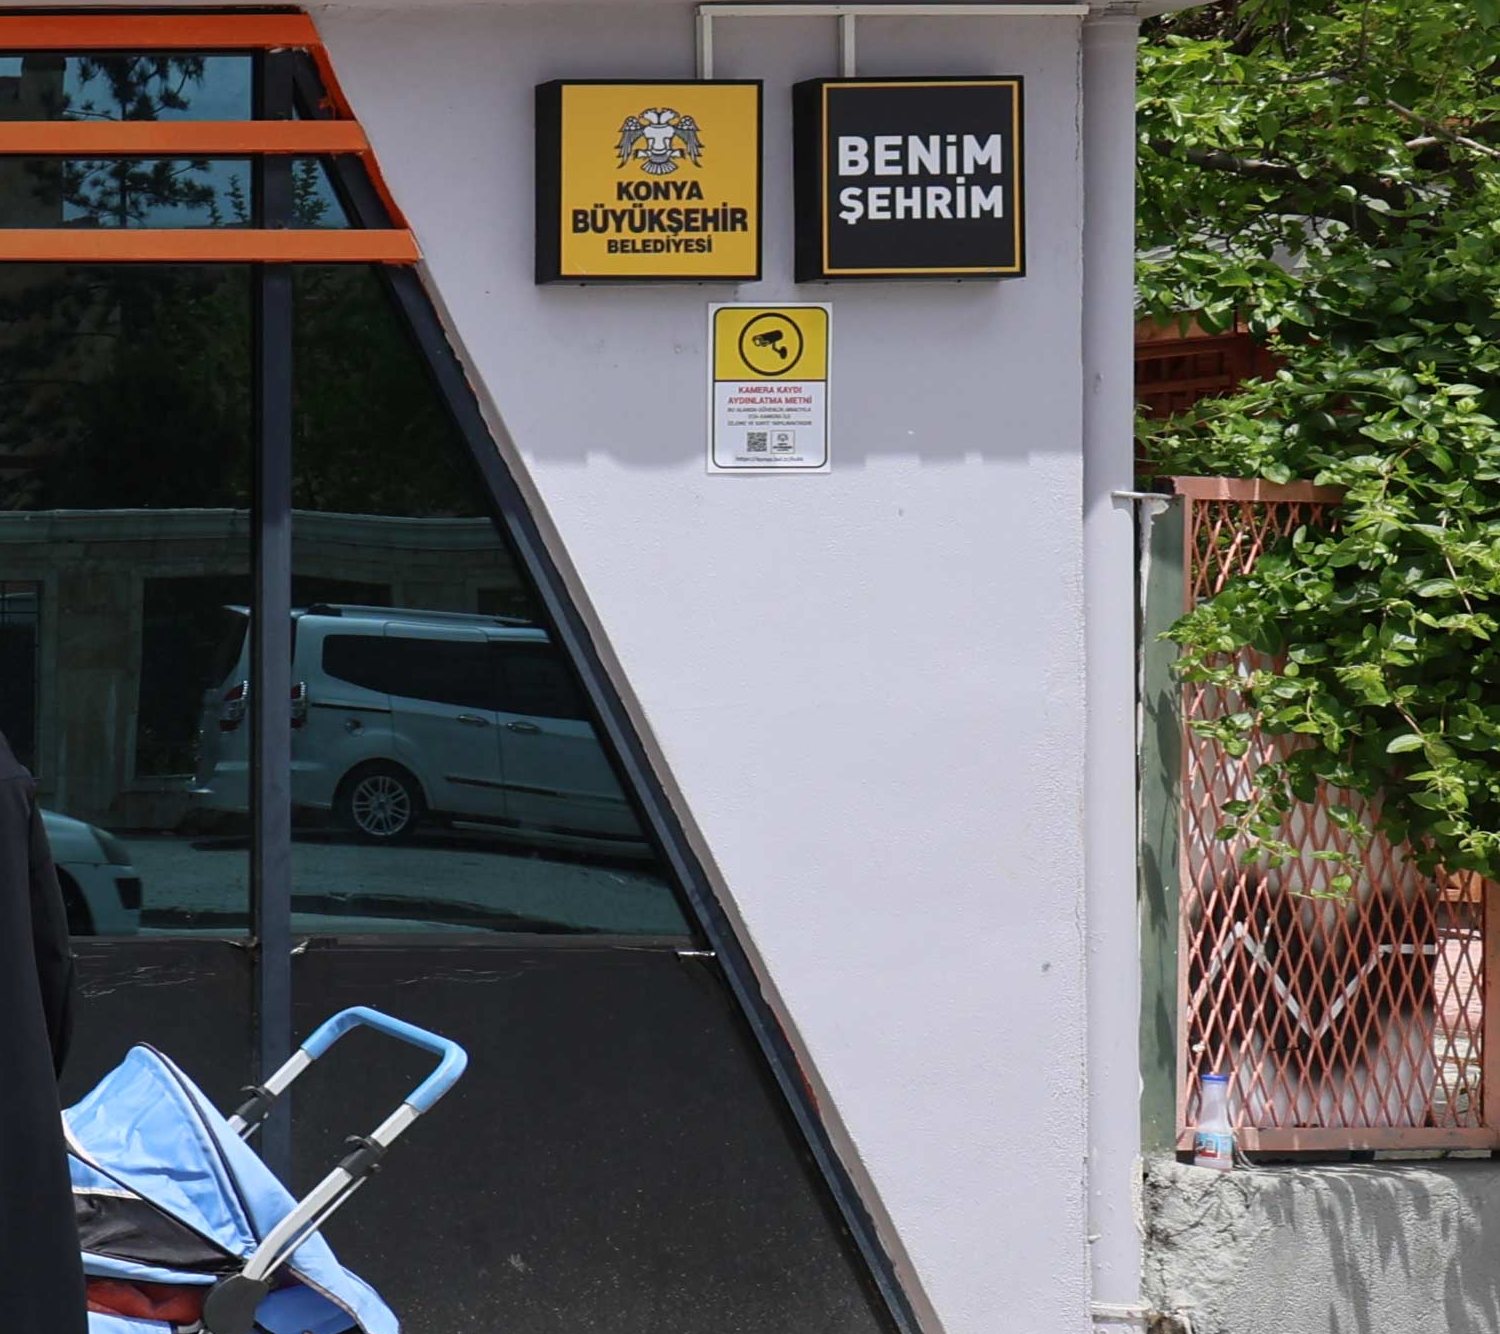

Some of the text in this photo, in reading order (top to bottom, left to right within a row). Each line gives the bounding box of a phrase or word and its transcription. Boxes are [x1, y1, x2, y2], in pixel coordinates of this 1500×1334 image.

[616, 180, 704, 202] KONYA
[838, 177, 1003, 225] ŞEHRİM
[571, 202, 748, 236] BÜYÜKŞEHİR
[606, 235, 713, 254] BELEDİYESİ
[738, 386, 775, 394] KAMERA
